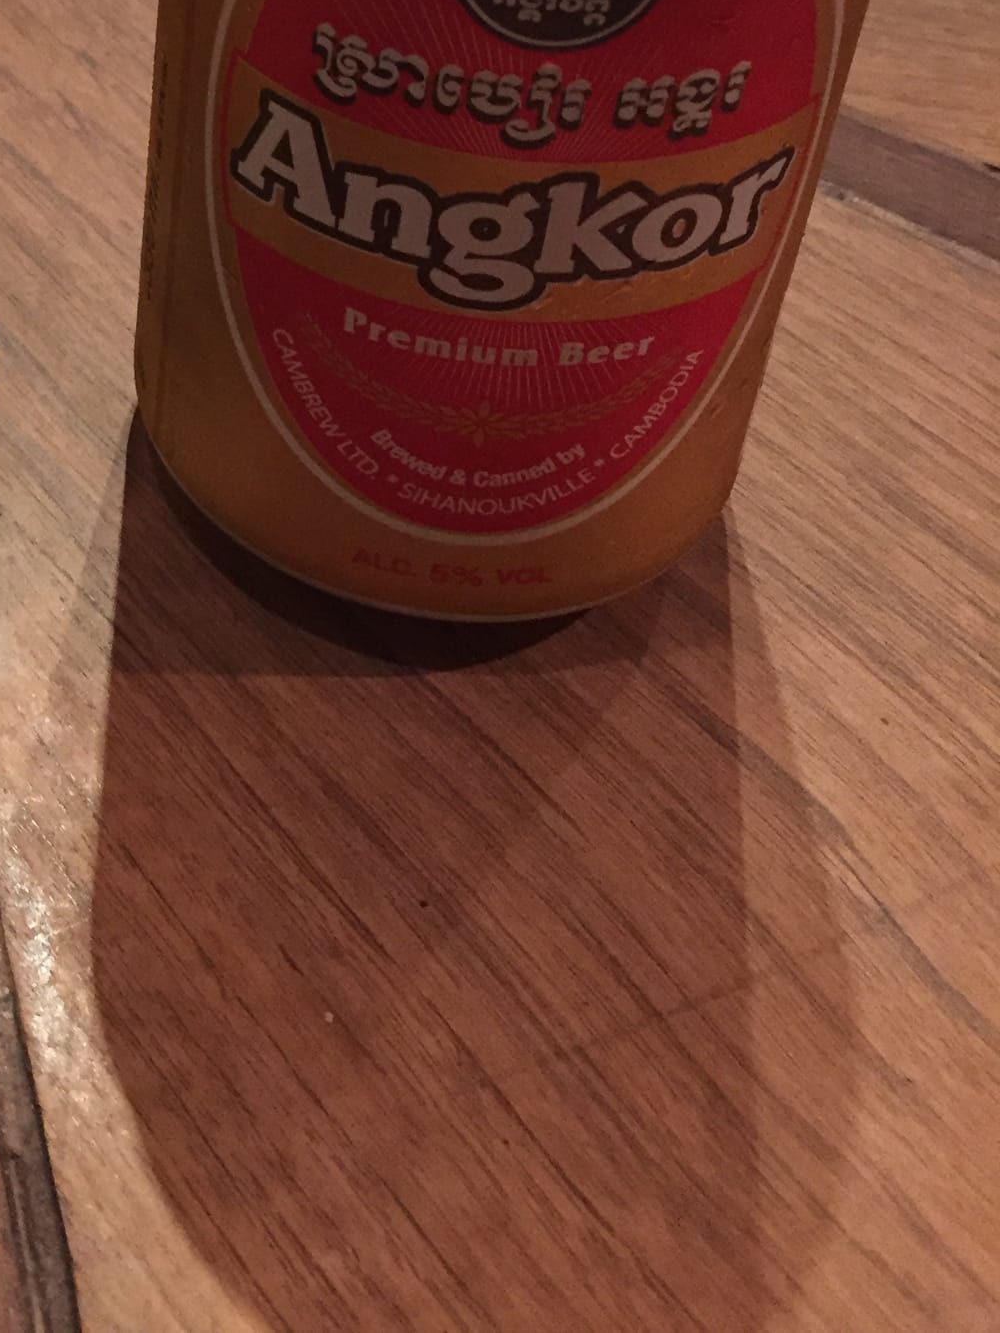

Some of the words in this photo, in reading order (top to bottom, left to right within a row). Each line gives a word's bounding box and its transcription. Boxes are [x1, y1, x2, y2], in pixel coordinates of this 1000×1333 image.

[229, 90, 796, 311] Angkor
[343, 307, 538, 367] Premium
[558, 335, 655, 366] Beer
[272, 328, 346, 438] CAMBREW
[398, 469, 595, 515] SIHANOUKVILLE
[610, 349, 704, 459] CAMBODIA
[370, 428, 447, 480] Brewed
[449, 469, 467, 486] &
[473, 457, 557, 488] Canned
[556, 442, 585, 464] by
[429, 562, 484, 587] 5%
